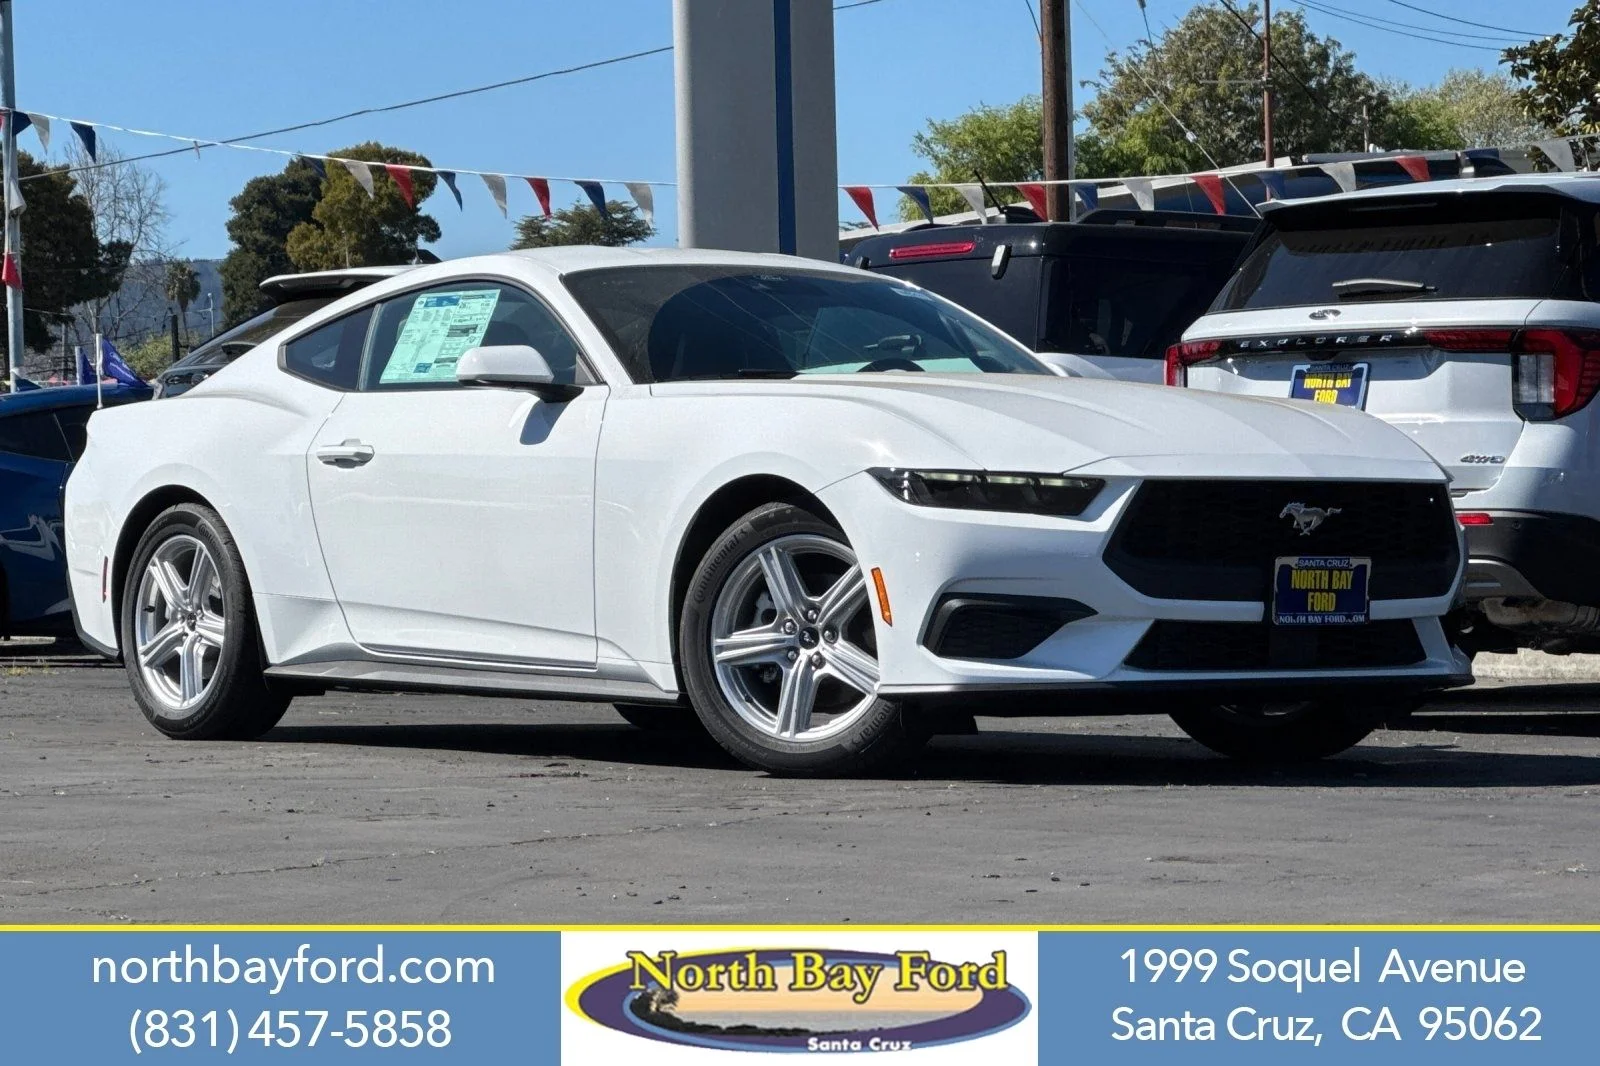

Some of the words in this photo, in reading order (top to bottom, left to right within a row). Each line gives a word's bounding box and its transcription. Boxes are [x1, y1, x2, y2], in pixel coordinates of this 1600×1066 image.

[1239, 334, 1393, 348] EXPLORER
[1304, 373, 1334, 389] NORTH
[1314, 389, 1339, 404] FORD
[1460, 454, 1506, 464] 4WD
[1298, 559, 1326, 568] SANTA
[1326, 559, 1350, 568] CRUZ
[1291, 569, 1329, 590] NORTH
[1331, 569, 1354, 590] BAY
[1307, 591, 1337, 612] FORD
[1308, 614, 1323, 624] BAY
